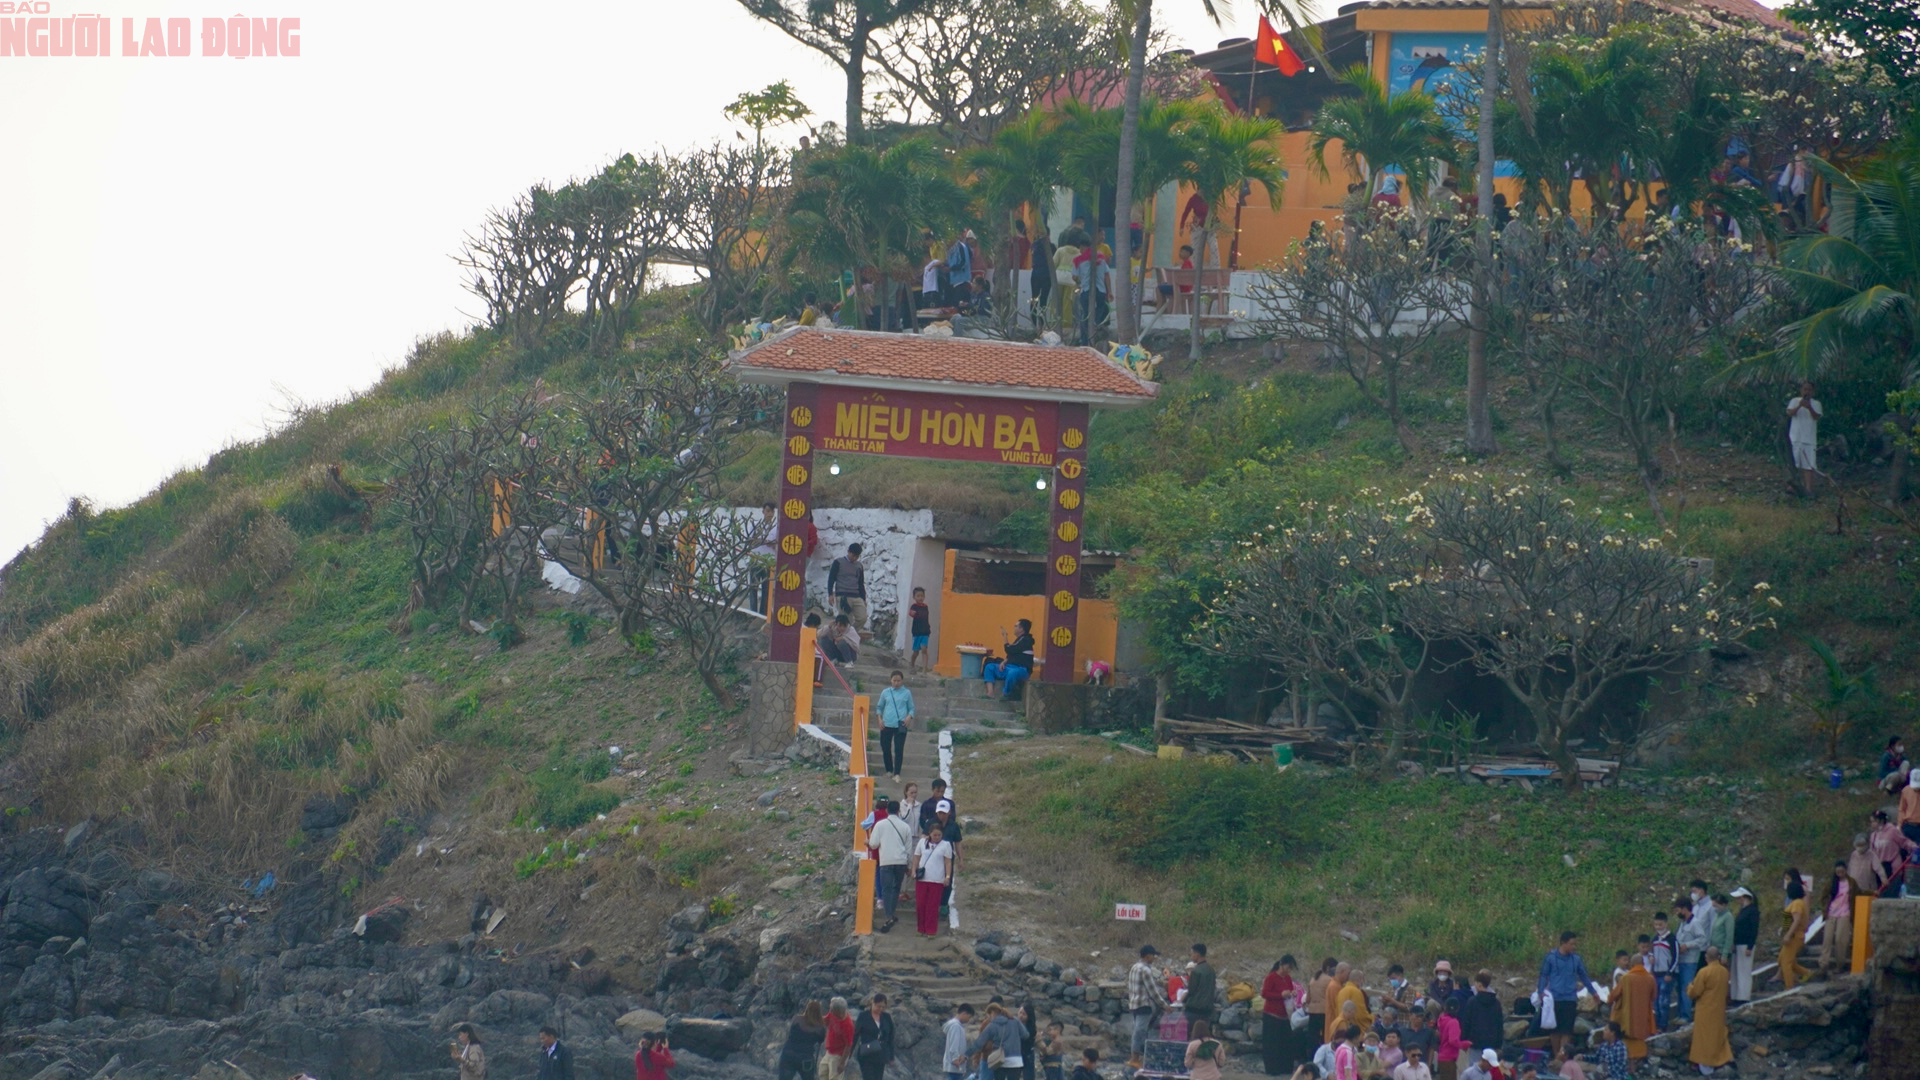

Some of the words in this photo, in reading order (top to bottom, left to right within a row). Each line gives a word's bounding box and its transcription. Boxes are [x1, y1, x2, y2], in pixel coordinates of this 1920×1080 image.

[835, 392, 911, 441] MIẾU
[920, 401, 985, 448] HÒN
[993, 405, 1040, 452] BÀ
